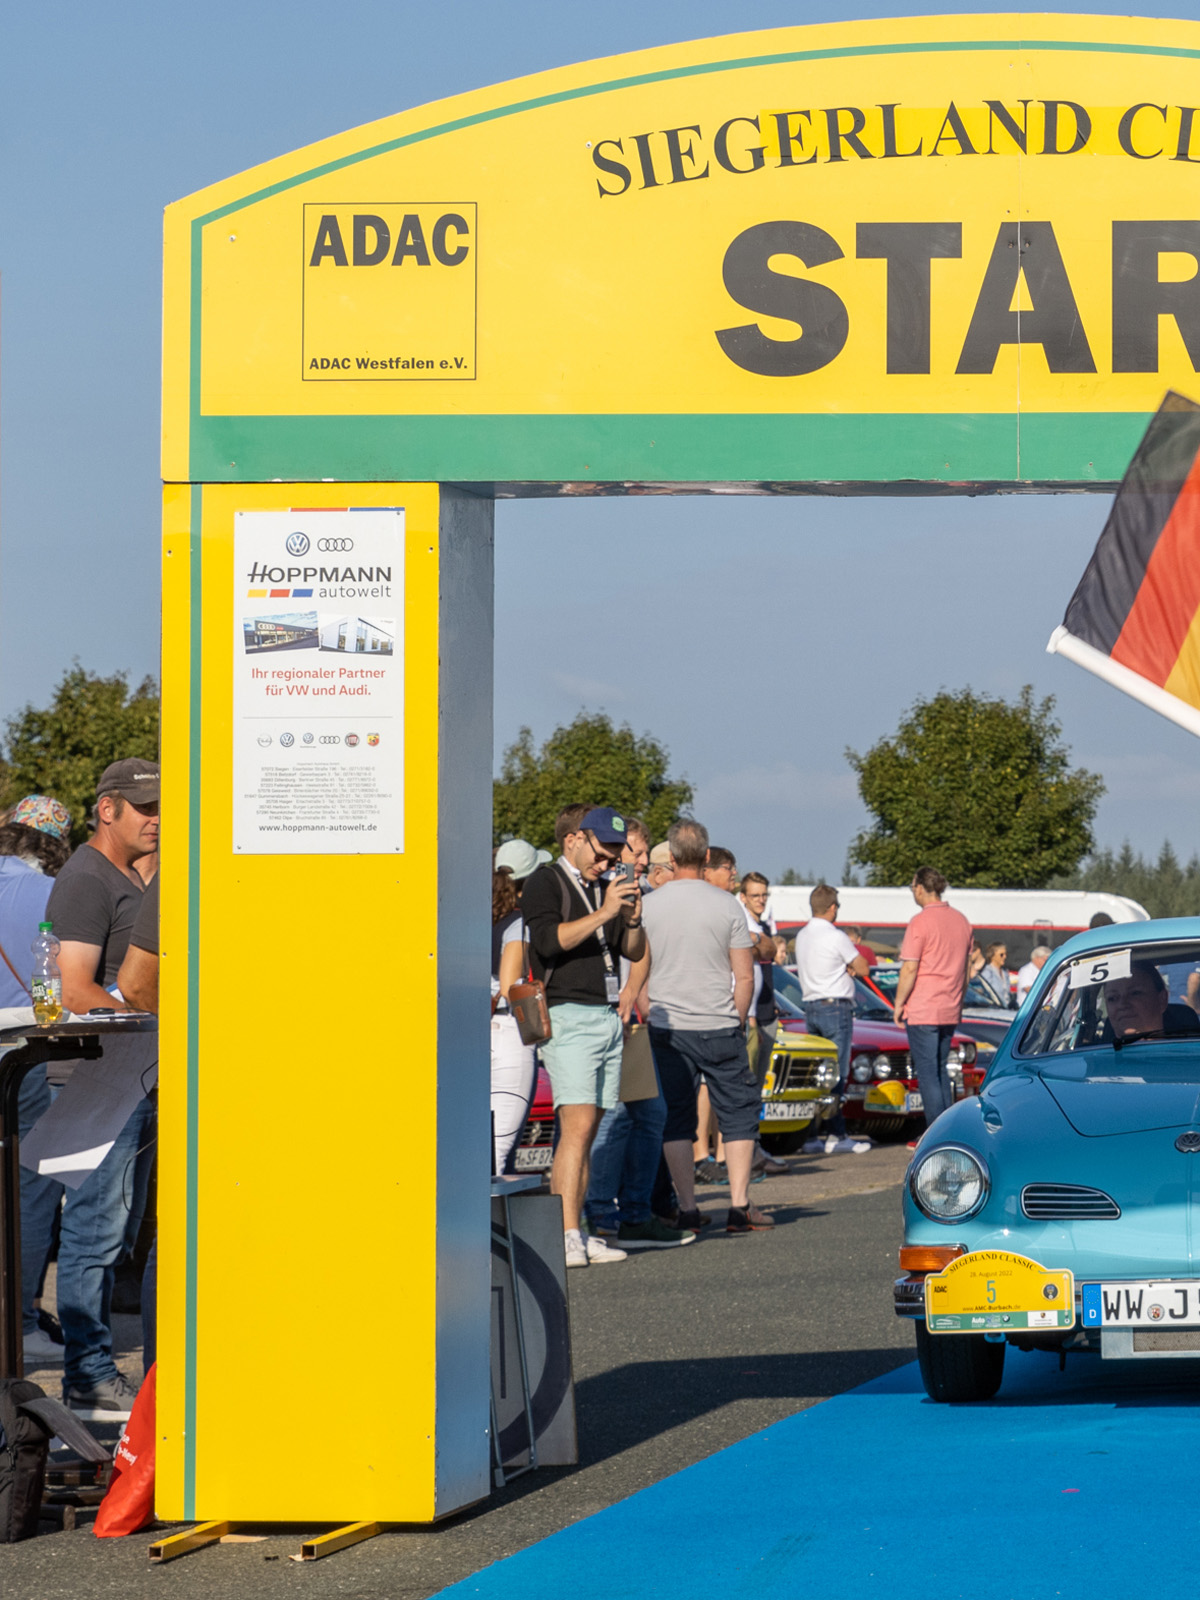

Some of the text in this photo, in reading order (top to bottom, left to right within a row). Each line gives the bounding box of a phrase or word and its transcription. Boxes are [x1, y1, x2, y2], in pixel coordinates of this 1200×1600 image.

[592, 100, 1091, 198] SIEGERLAND
[309, 213, 469, 267] ADAC
[309, 356, 468, 370] ADAC Westfalen e.V.
[247, 562, 391, 583] HOPPMANN
[319, 585, 391, 598] autowelt
[252, 668, 386, 682] Ihr regionaler Partner
[265, 684, 371, 696] für VW und Audi.
[259, 824, 377, 832] www.hoppmann-autowelt.de
[1090, 962, 1109, 982] 5
[949, 1253, 1037, 1274] SIEGERLAND CLASSIC
[934, 1285, 947, 1293] ADAC
[986, 1280, 996, 1303] 5
[1103, 1289, 1144, 1320] WW
[1169, 1289, 1188, 1319] J
[1089, 1309, 1096, 1318] D
